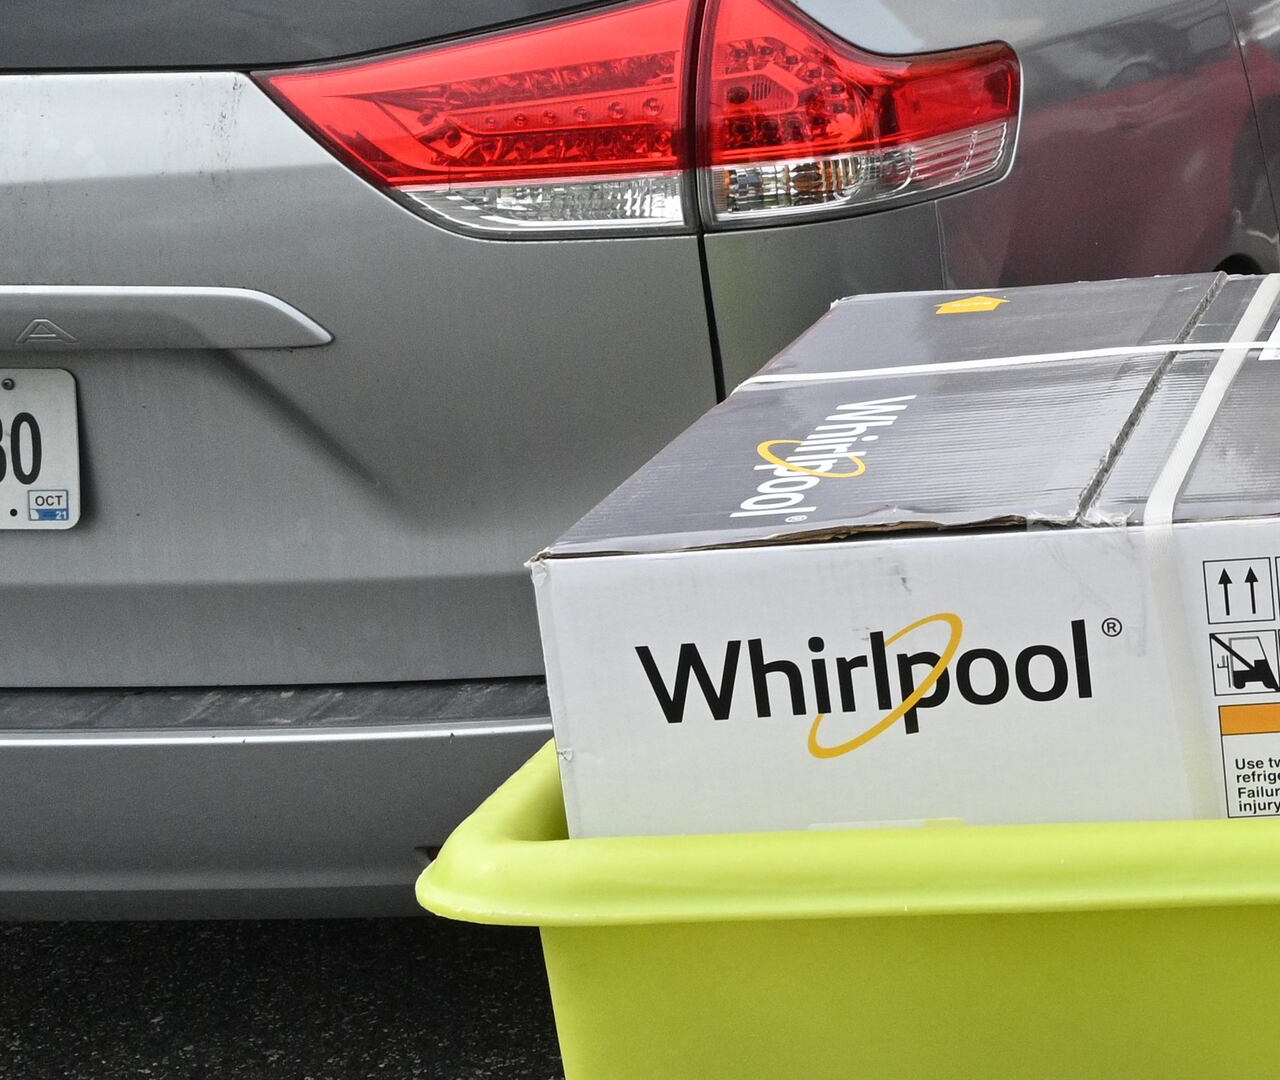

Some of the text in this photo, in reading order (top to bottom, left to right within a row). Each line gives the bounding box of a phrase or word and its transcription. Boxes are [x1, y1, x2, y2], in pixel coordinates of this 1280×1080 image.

[0, 412, 42, 485] 0
[729, 394, 917, 518] Whirlpool
[35, 495, 63, 507] OCT
[55, 510, 67, 520] 21
[634, 619, 1093, 735] Whirlpool
[1235, 757, 1264, 771] Use
